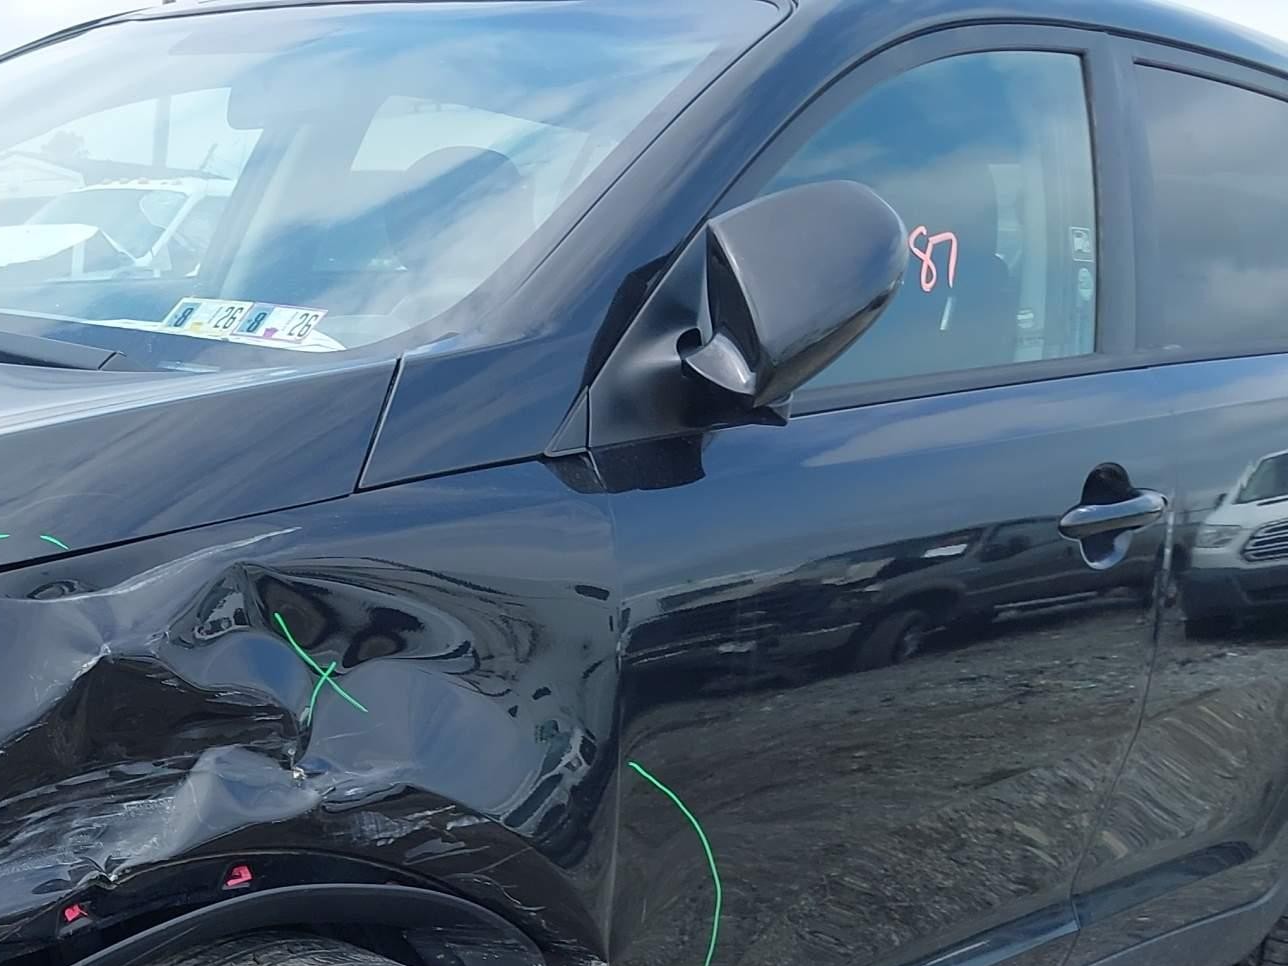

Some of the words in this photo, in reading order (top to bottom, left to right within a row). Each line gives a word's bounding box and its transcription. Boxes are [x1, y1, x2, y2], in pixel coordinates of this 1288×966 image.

[908, 225, 958, 293] 87
[173, 307, 194, 327] 8
[212, 306, 244, 329] 26
[246, 311, 268, 333] 8
[287, 312, 319, 337] 26
